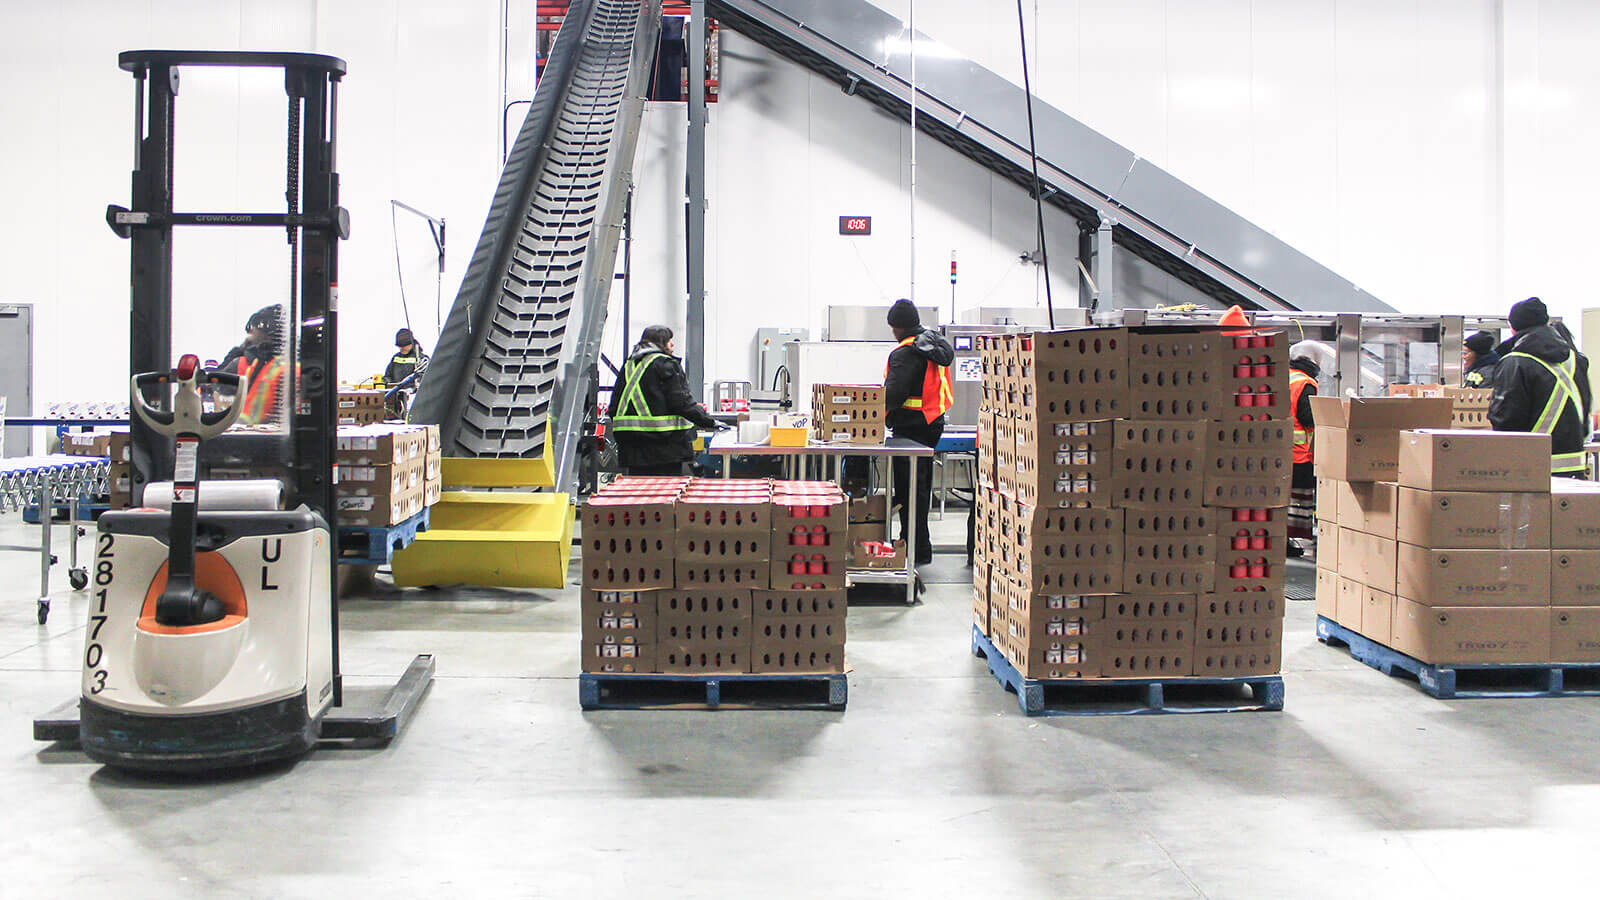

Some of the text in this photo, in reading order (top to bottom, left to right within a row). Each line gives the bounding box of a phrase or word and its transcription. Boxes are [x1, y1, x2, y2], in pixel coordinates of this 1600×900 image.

[195, 214, 252, 222] crown.com
[847, 219, 866, 230] 10:06
[262, 539, 281, 591] UL
[86, 533, 115, 694] 281703
